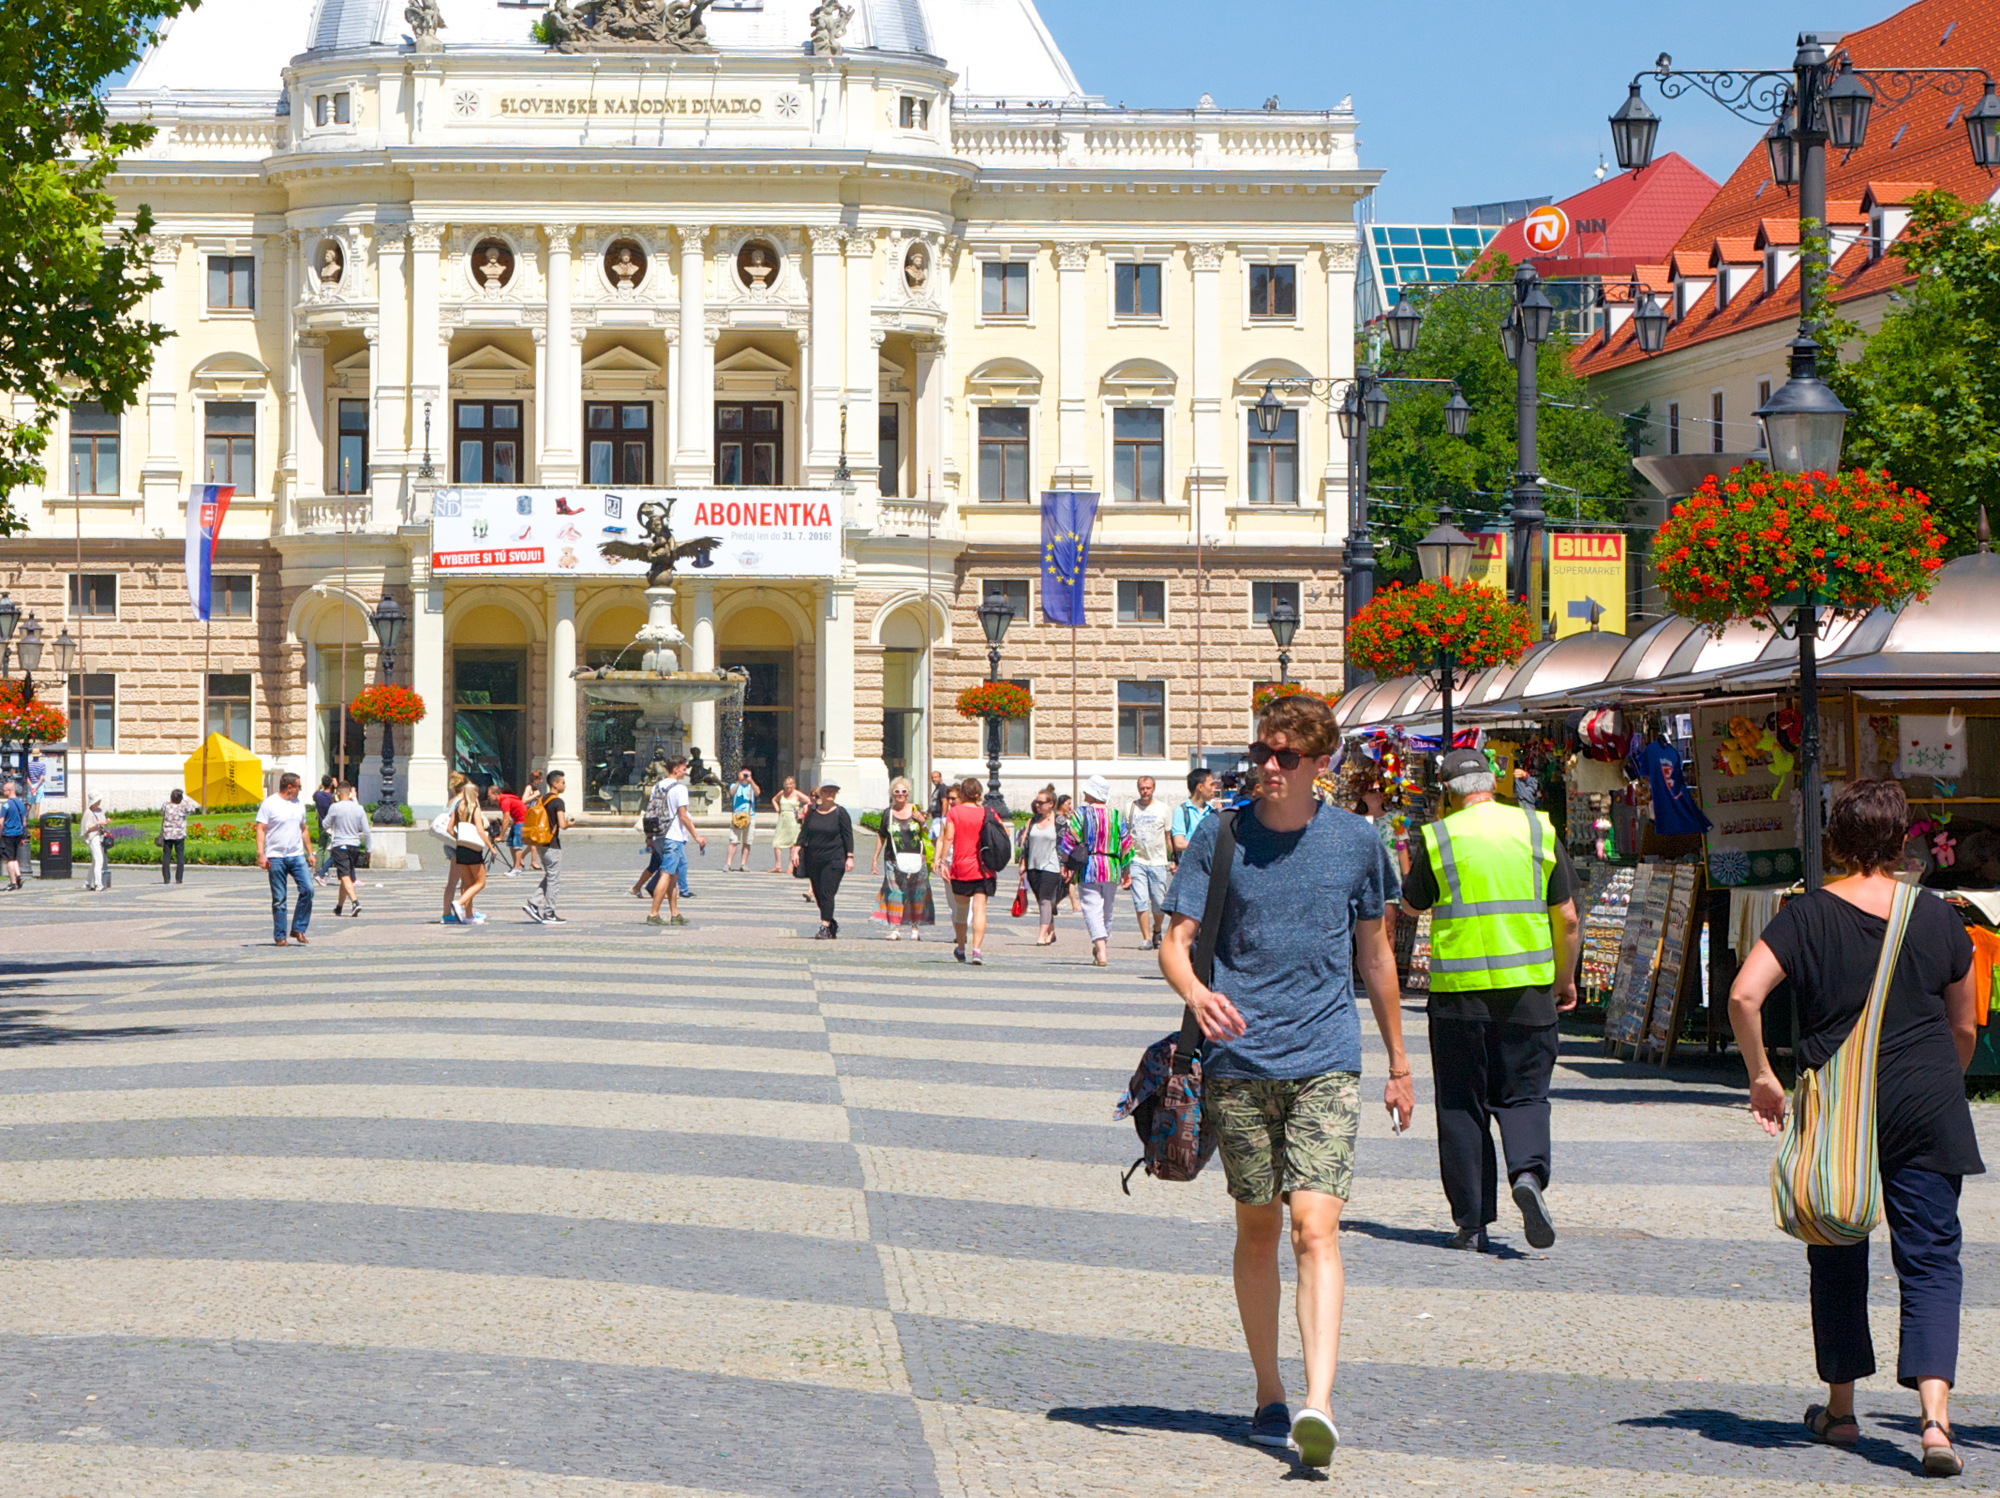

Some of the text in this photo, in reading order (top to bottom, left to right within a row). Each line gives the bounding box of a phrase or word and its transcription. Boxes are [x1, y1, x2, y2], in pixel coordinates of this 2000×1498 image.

[604, 95, 687, 114] NÁRODNÉ
[692, 98, 762, 114] DIVADLO
[1576, 218, 1606, 234] NN
[694, 502, 832, 527] ABONENTKA
[731, 532, 832, 542] Predaj len do 31. 7. 2016!
[1557, 538, 1618, 557] BILLA
[439, 549, 541, 566] VYBERTE SI TÚ SVOJU!
[1553, 566, 1621, 576] SUPERMARKET
